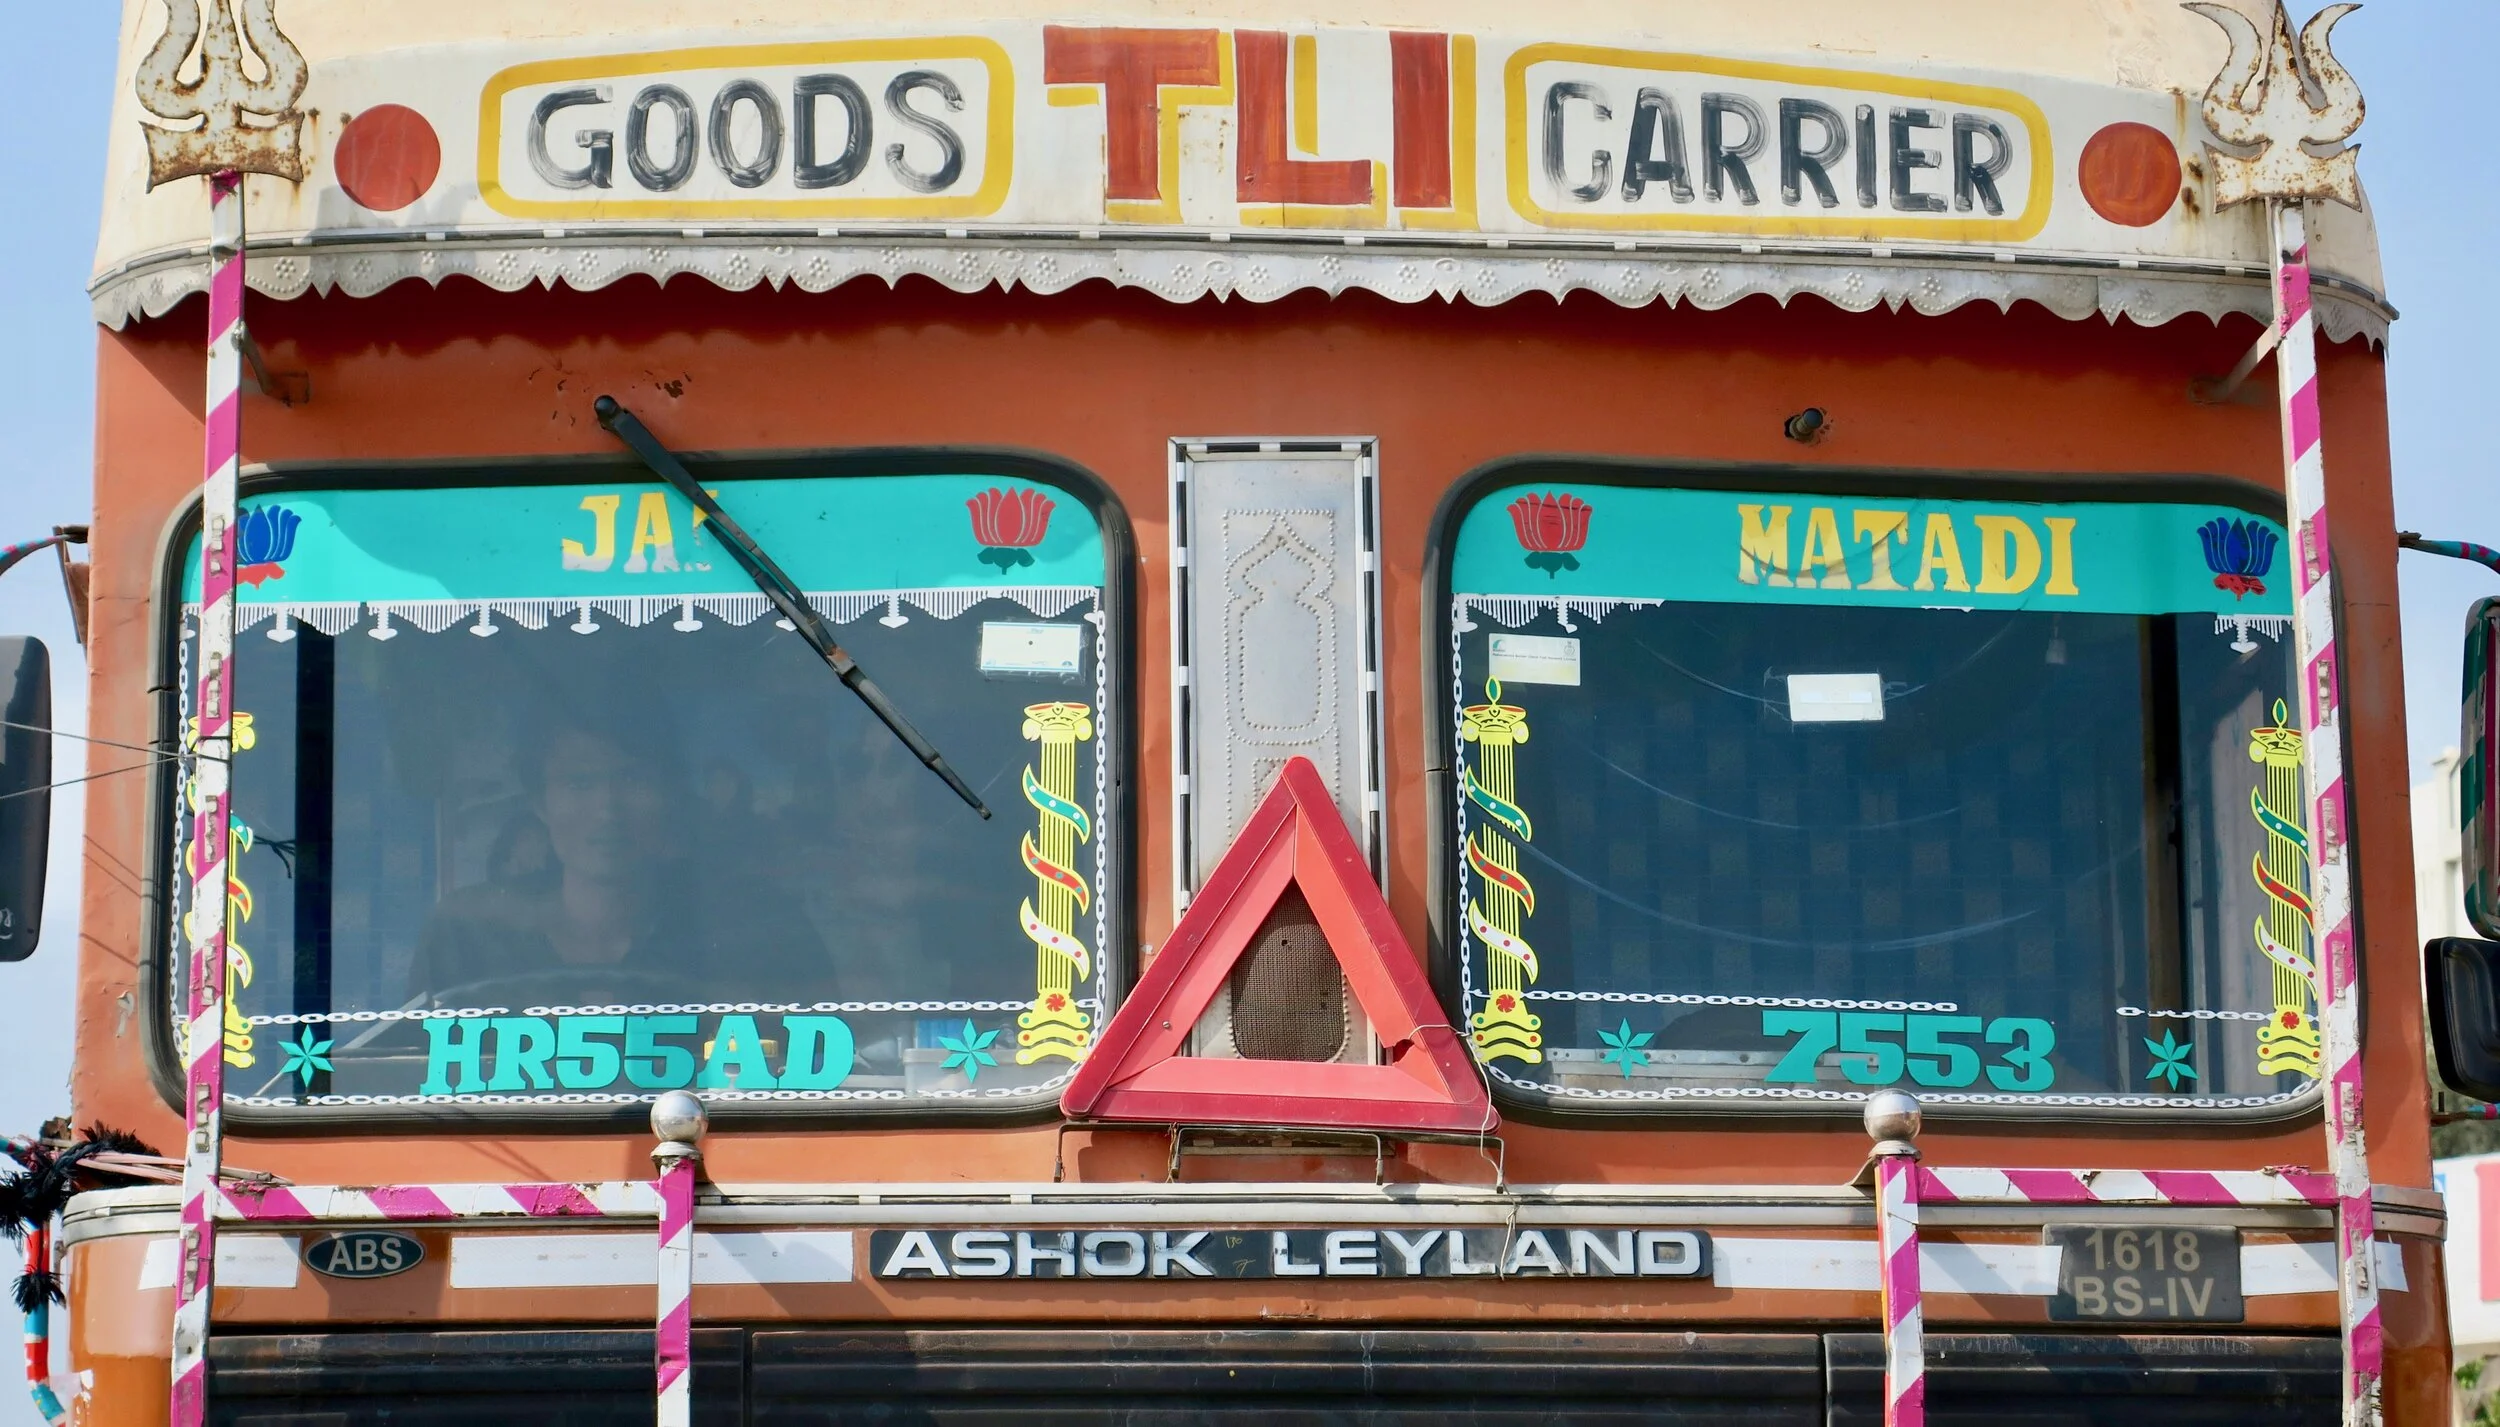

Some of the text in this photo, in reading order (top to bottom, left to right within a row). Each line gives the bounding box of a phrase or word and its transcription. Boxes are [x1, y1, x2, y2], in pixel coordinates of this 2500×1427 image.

[527, 25, 2013, 229] GOODS TLI CARRIER
[1737, 503, 2080, 596] MATADI
[420, 1010, 2056, 1095] HR55AD 7553
[327, 1237, 403, 1272] ABS
[882, 1231, 1215, 1277] ASHOK
[1273, 1230, 1702, 1276] LEYLAND
[2085, 1229, 2200, 1273] 1618
[2074, 1276, 2214, 1317] BS-IV
